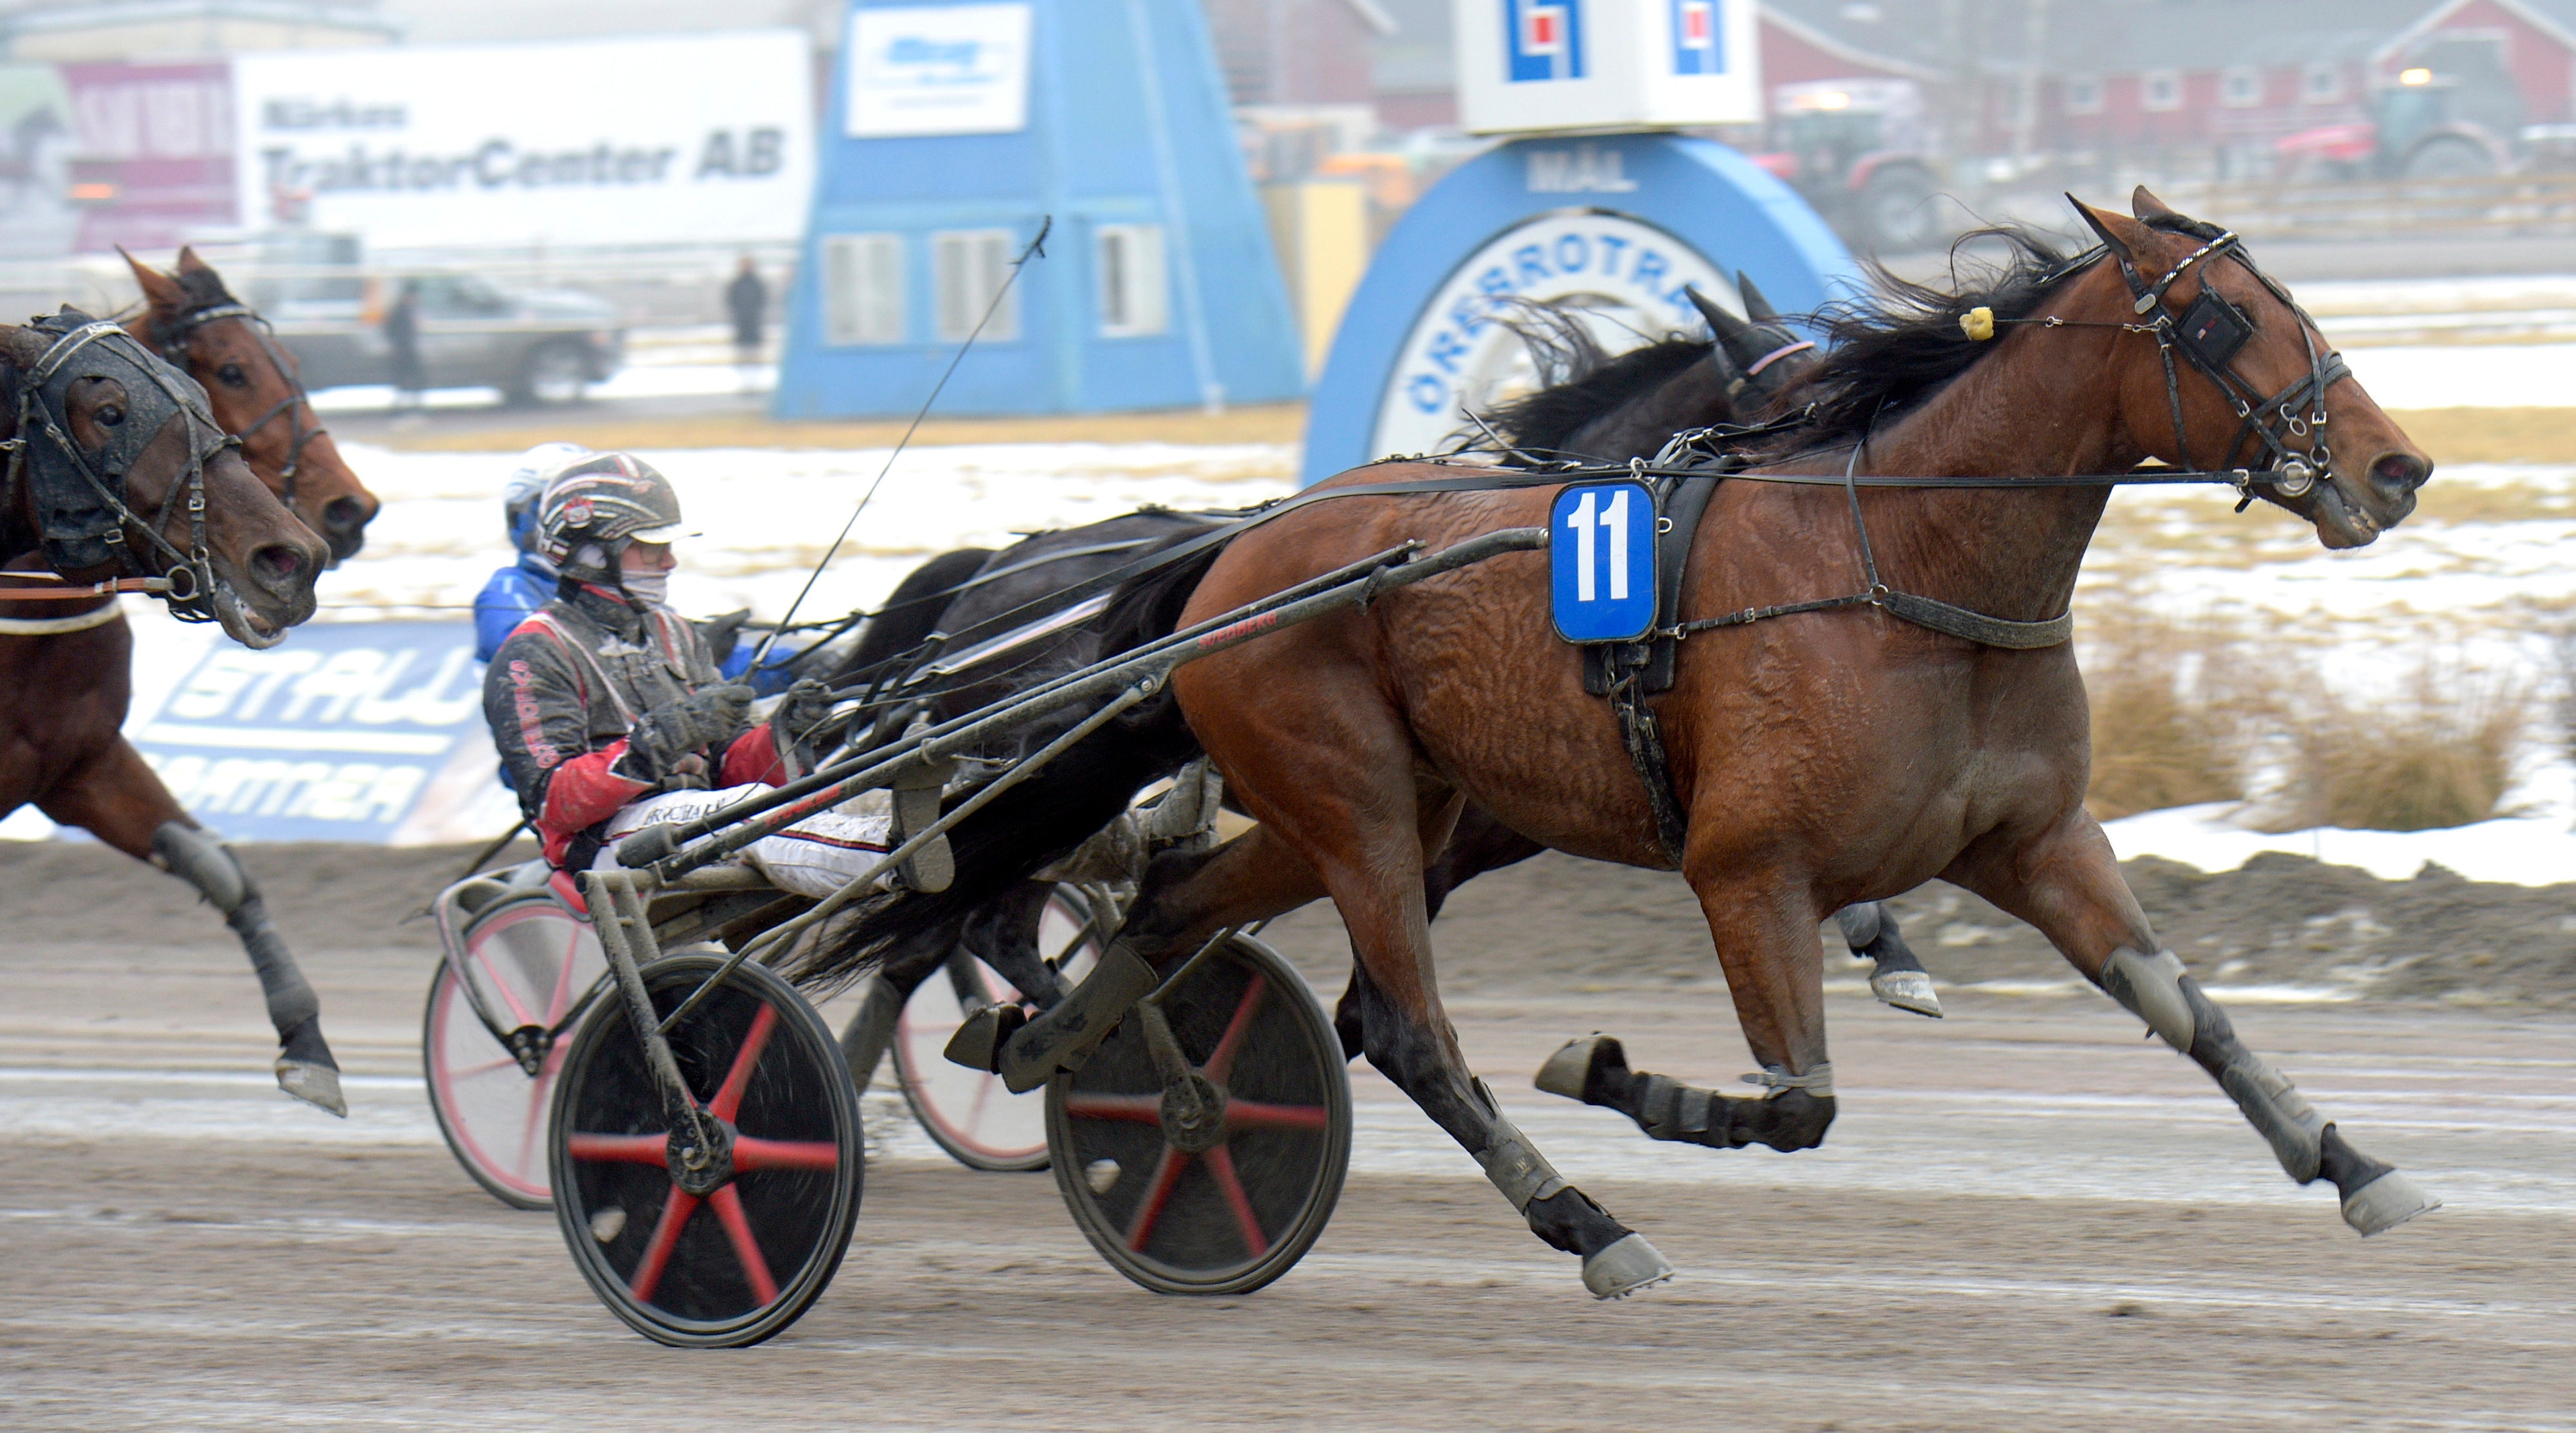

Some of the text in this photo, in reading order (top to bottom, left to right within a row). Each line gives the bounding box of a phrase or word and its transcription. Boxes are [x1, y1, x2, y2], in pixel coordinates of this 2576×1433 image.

[259, 125, 787, 193] TraktorCenter AB
[1526, 143, 1640, 193] MÅL
[1405, 233, 1709, 415] ÖREBROTRA
[1567, 490, 1629, 602] 11
